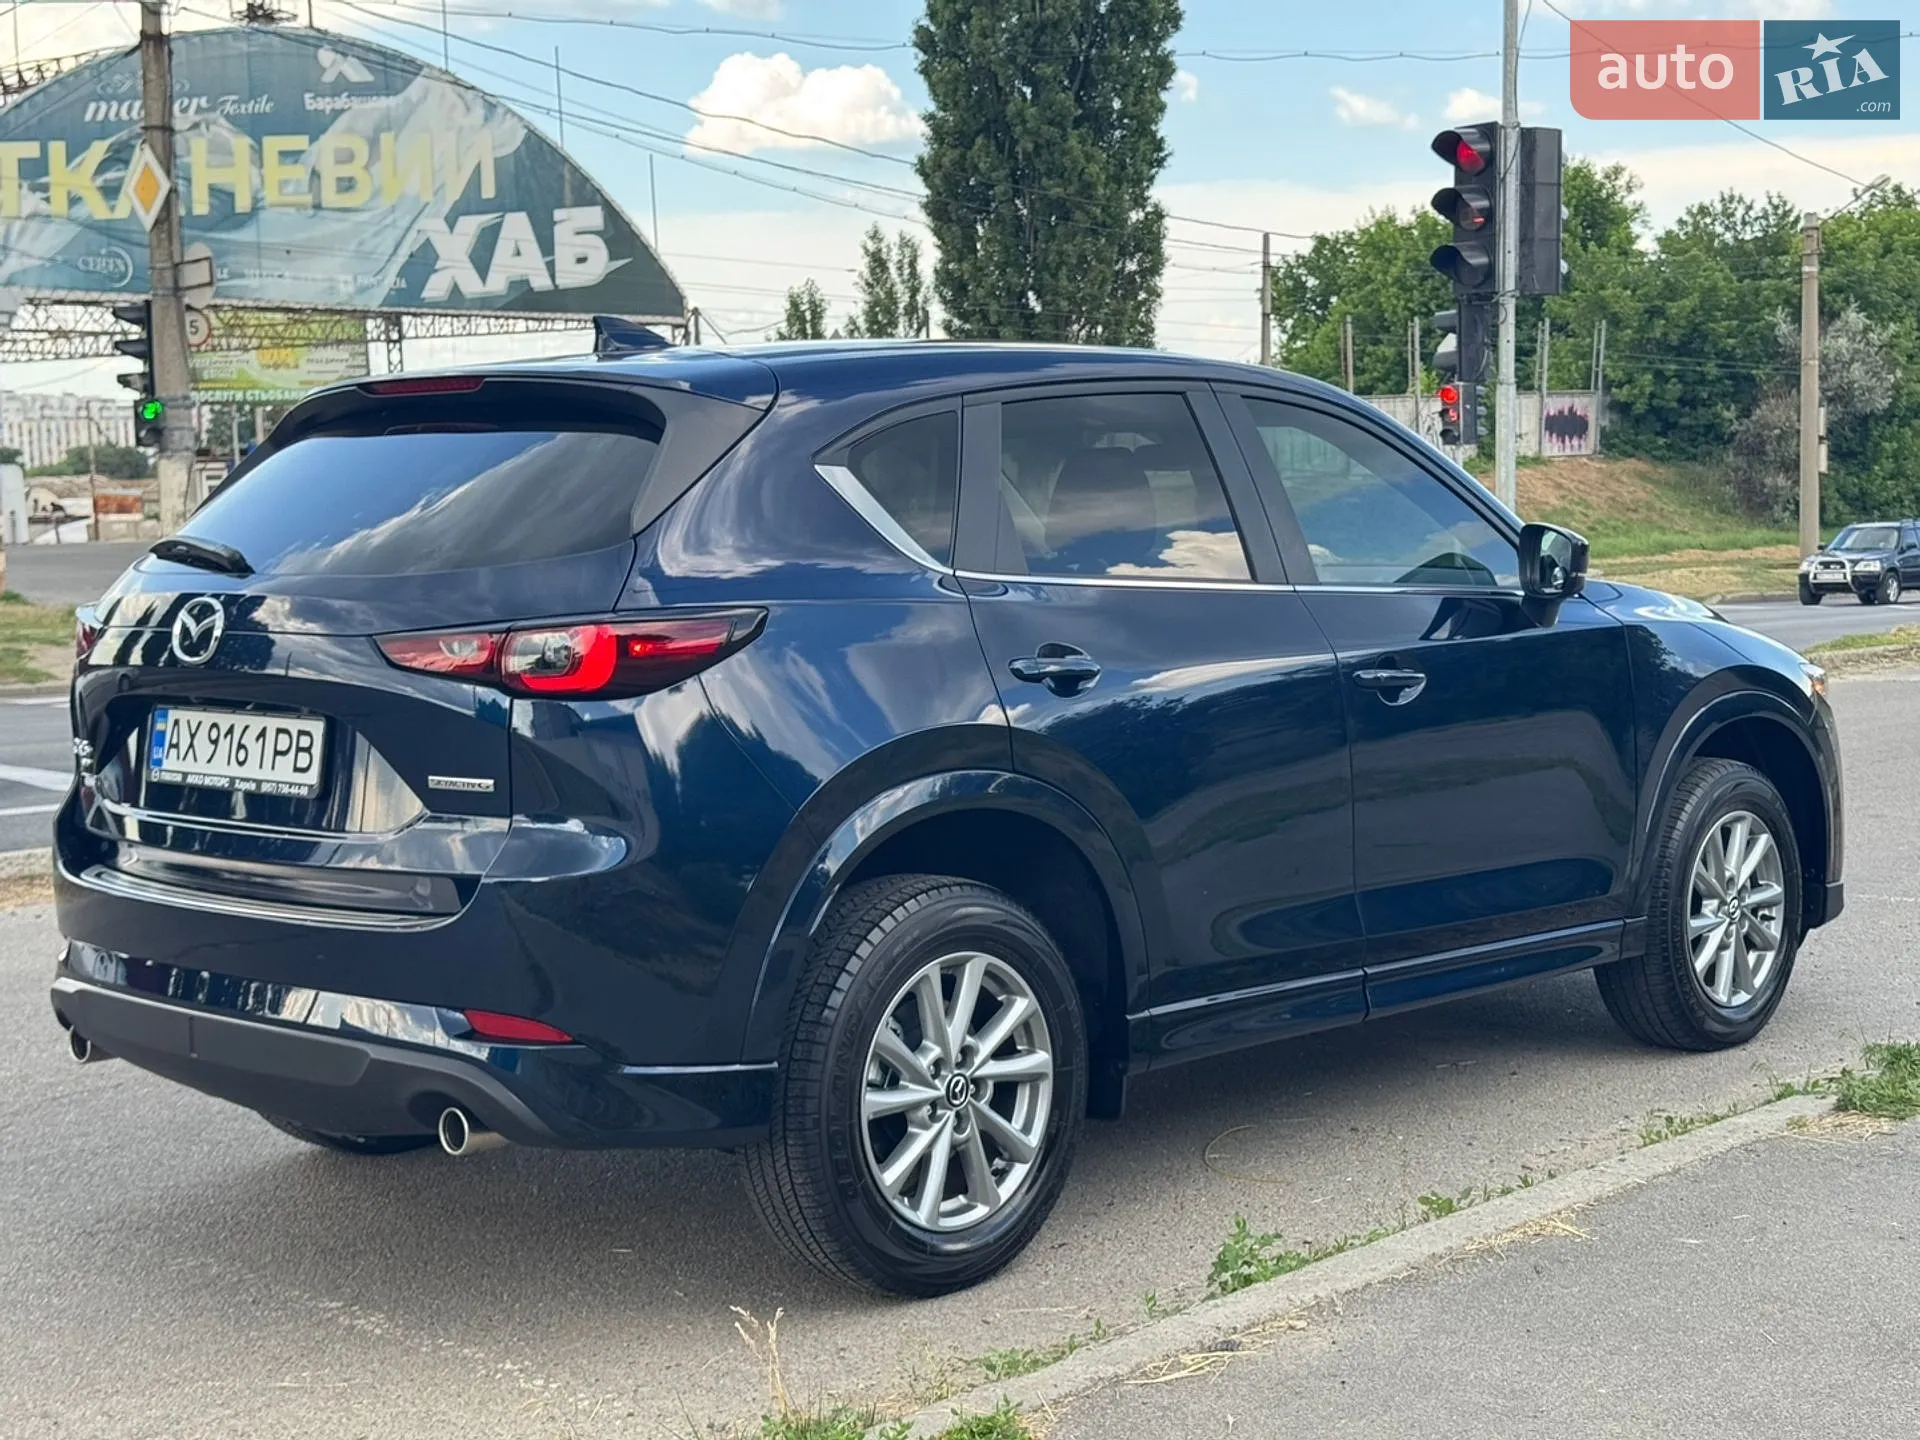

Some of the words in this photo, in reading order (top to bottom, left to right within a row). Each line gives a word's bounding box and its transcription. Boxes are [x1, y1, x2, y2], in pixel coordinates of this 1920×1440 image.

[83, 93, 211, 123] maer
[215, 93, 275, 116] Textile
[416, 204, 612, 303] ХАБ
